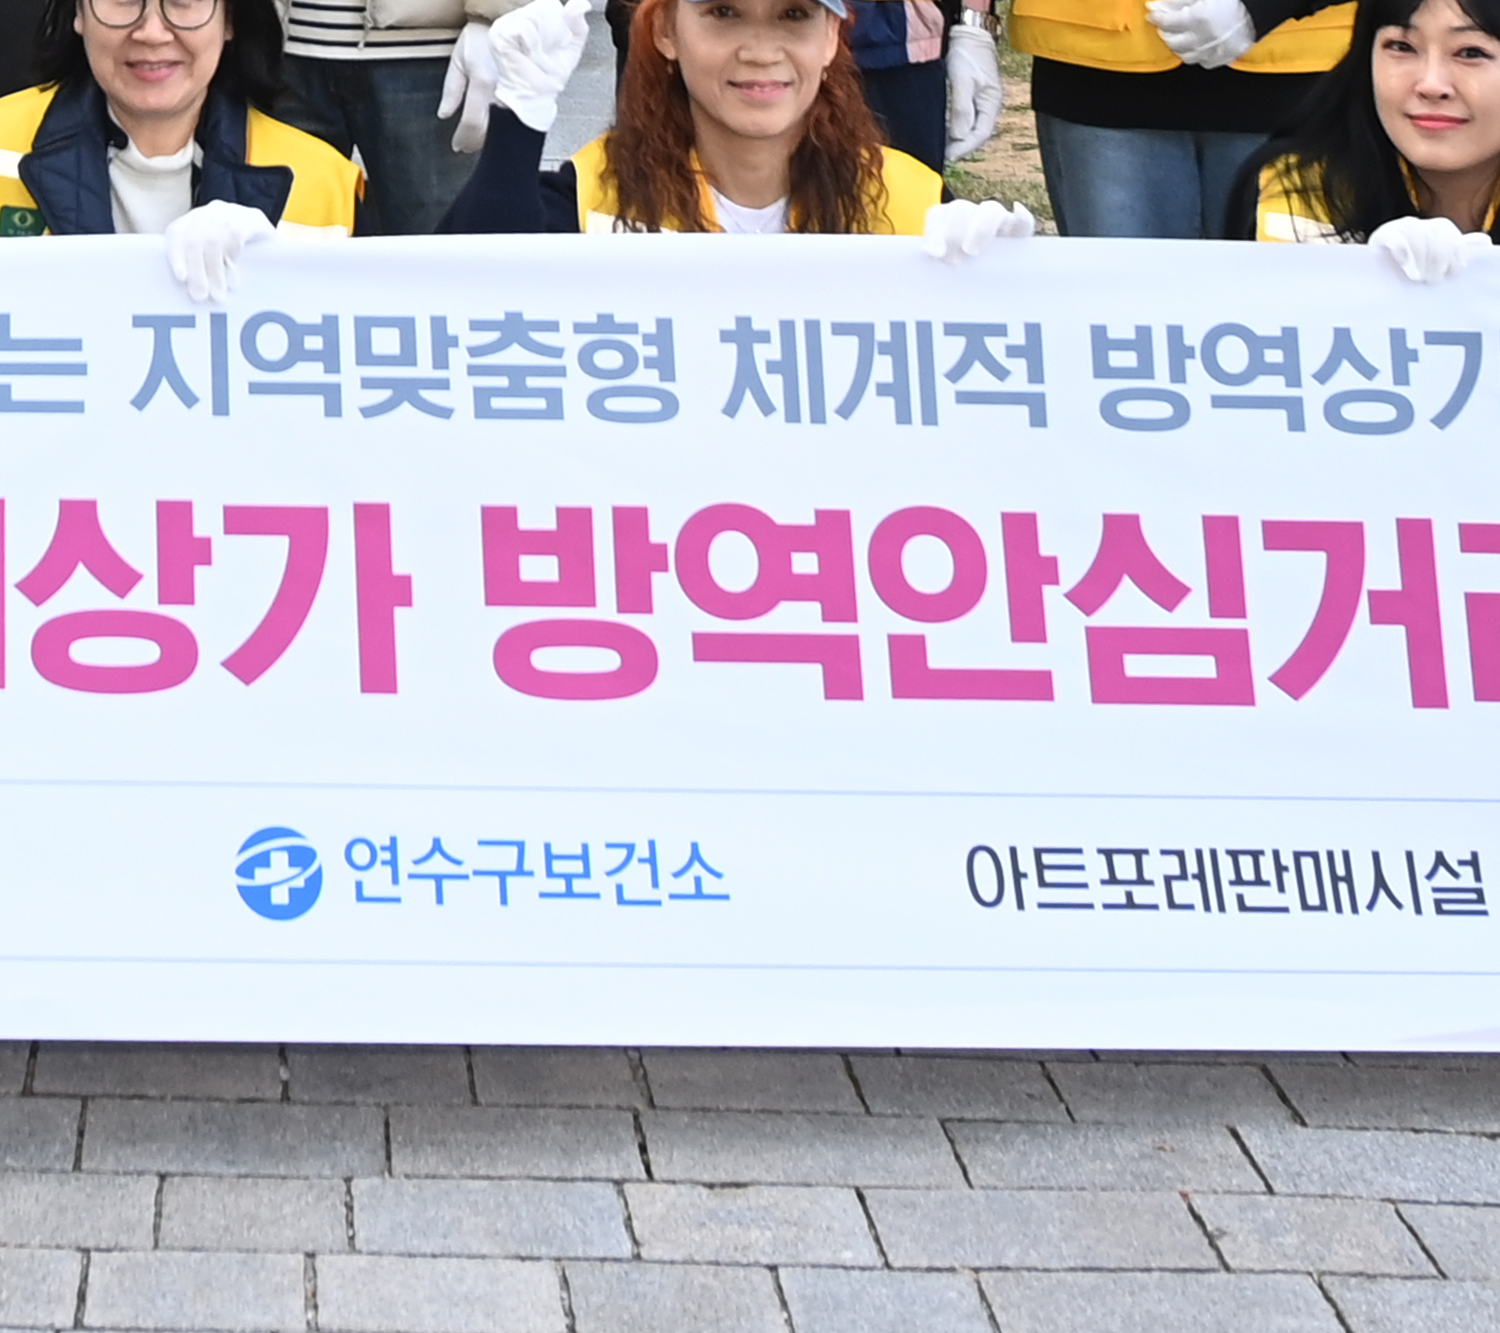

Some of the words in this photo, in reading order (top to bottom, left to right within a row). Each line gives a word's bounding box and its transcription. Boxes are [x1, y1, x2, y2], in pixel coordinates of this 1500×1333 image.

[129, 310, 680, 425] 지역맞춤형
[719, 315, 1050, 429] 체계적
[343, 835, 732, 908] 연수구보건소
[965, 844, 1490, 917] 아트포레판매시설
